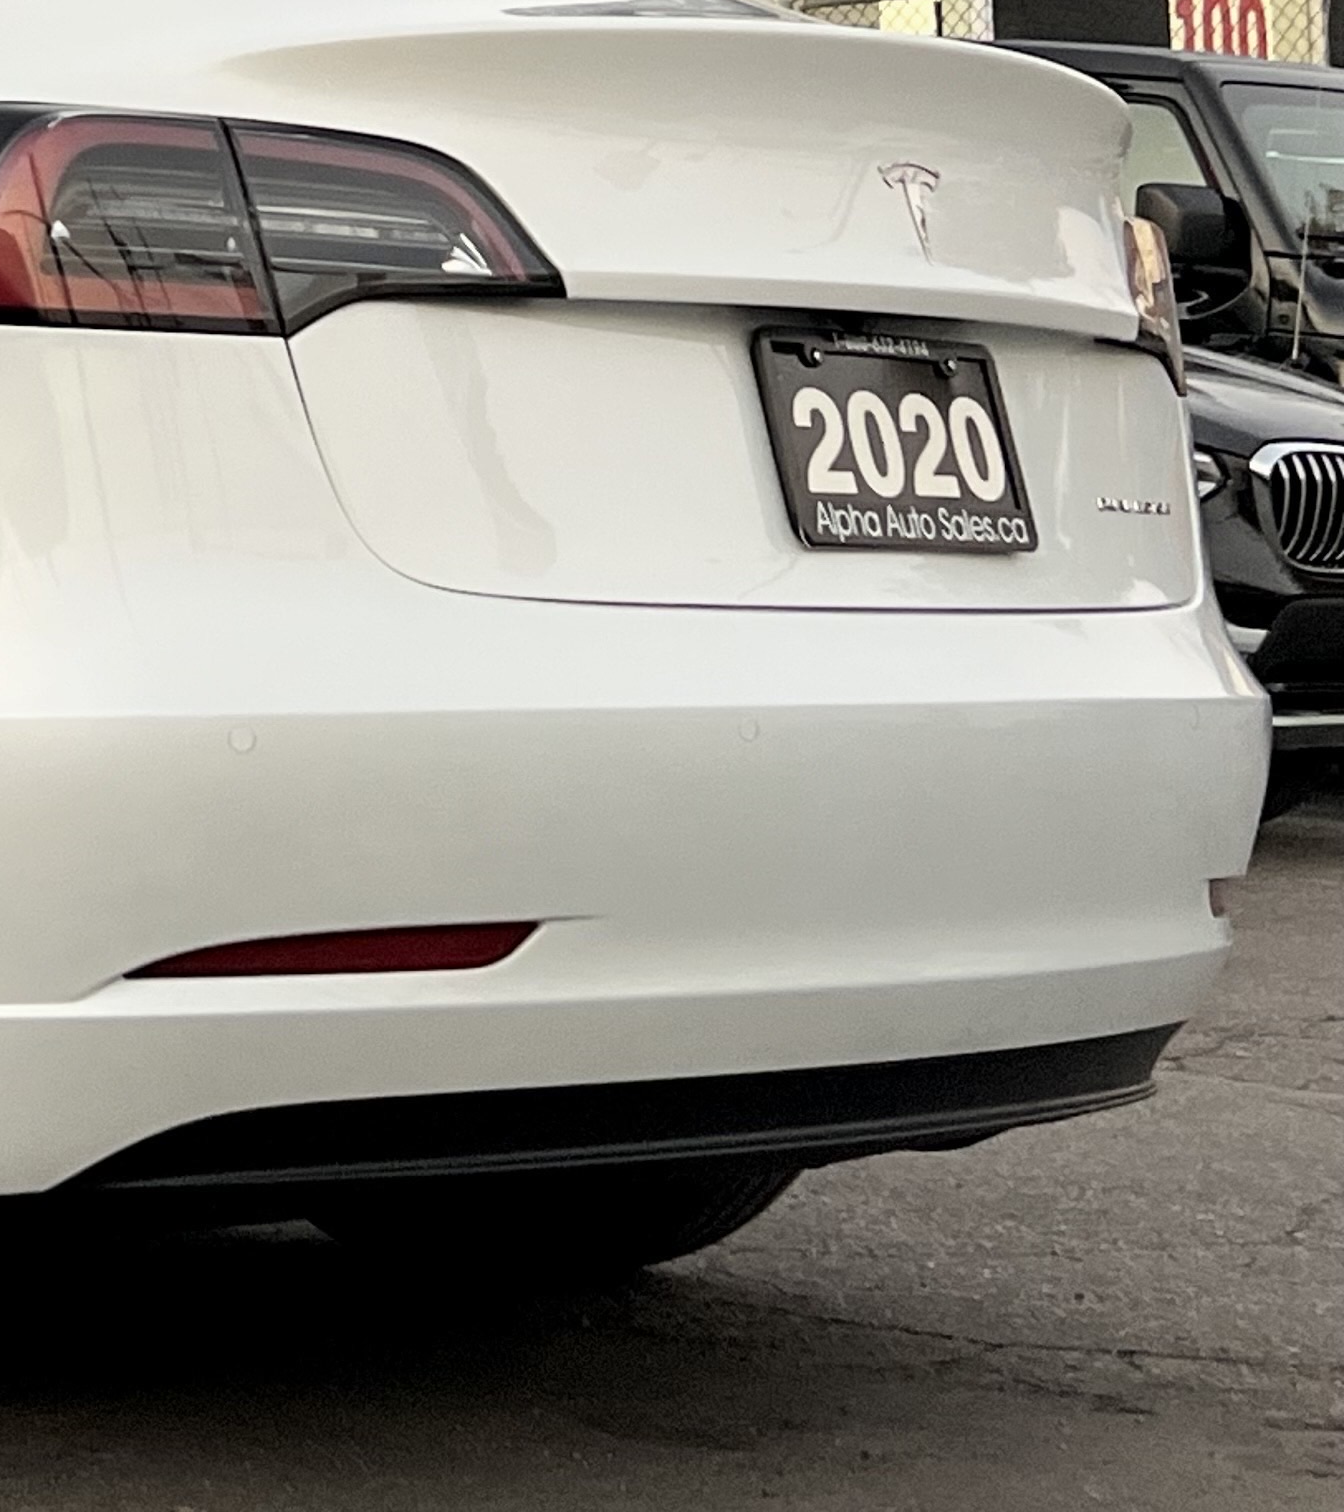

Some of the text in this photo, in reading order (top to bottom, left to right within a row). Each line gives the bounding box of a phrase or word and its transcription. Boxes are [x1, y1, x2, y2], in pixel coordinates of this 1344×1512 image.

[791, 386, 1008, 503] 2020
[816, 500, 883, 543] Alpha
[886, 504, 937, 540] Auto
